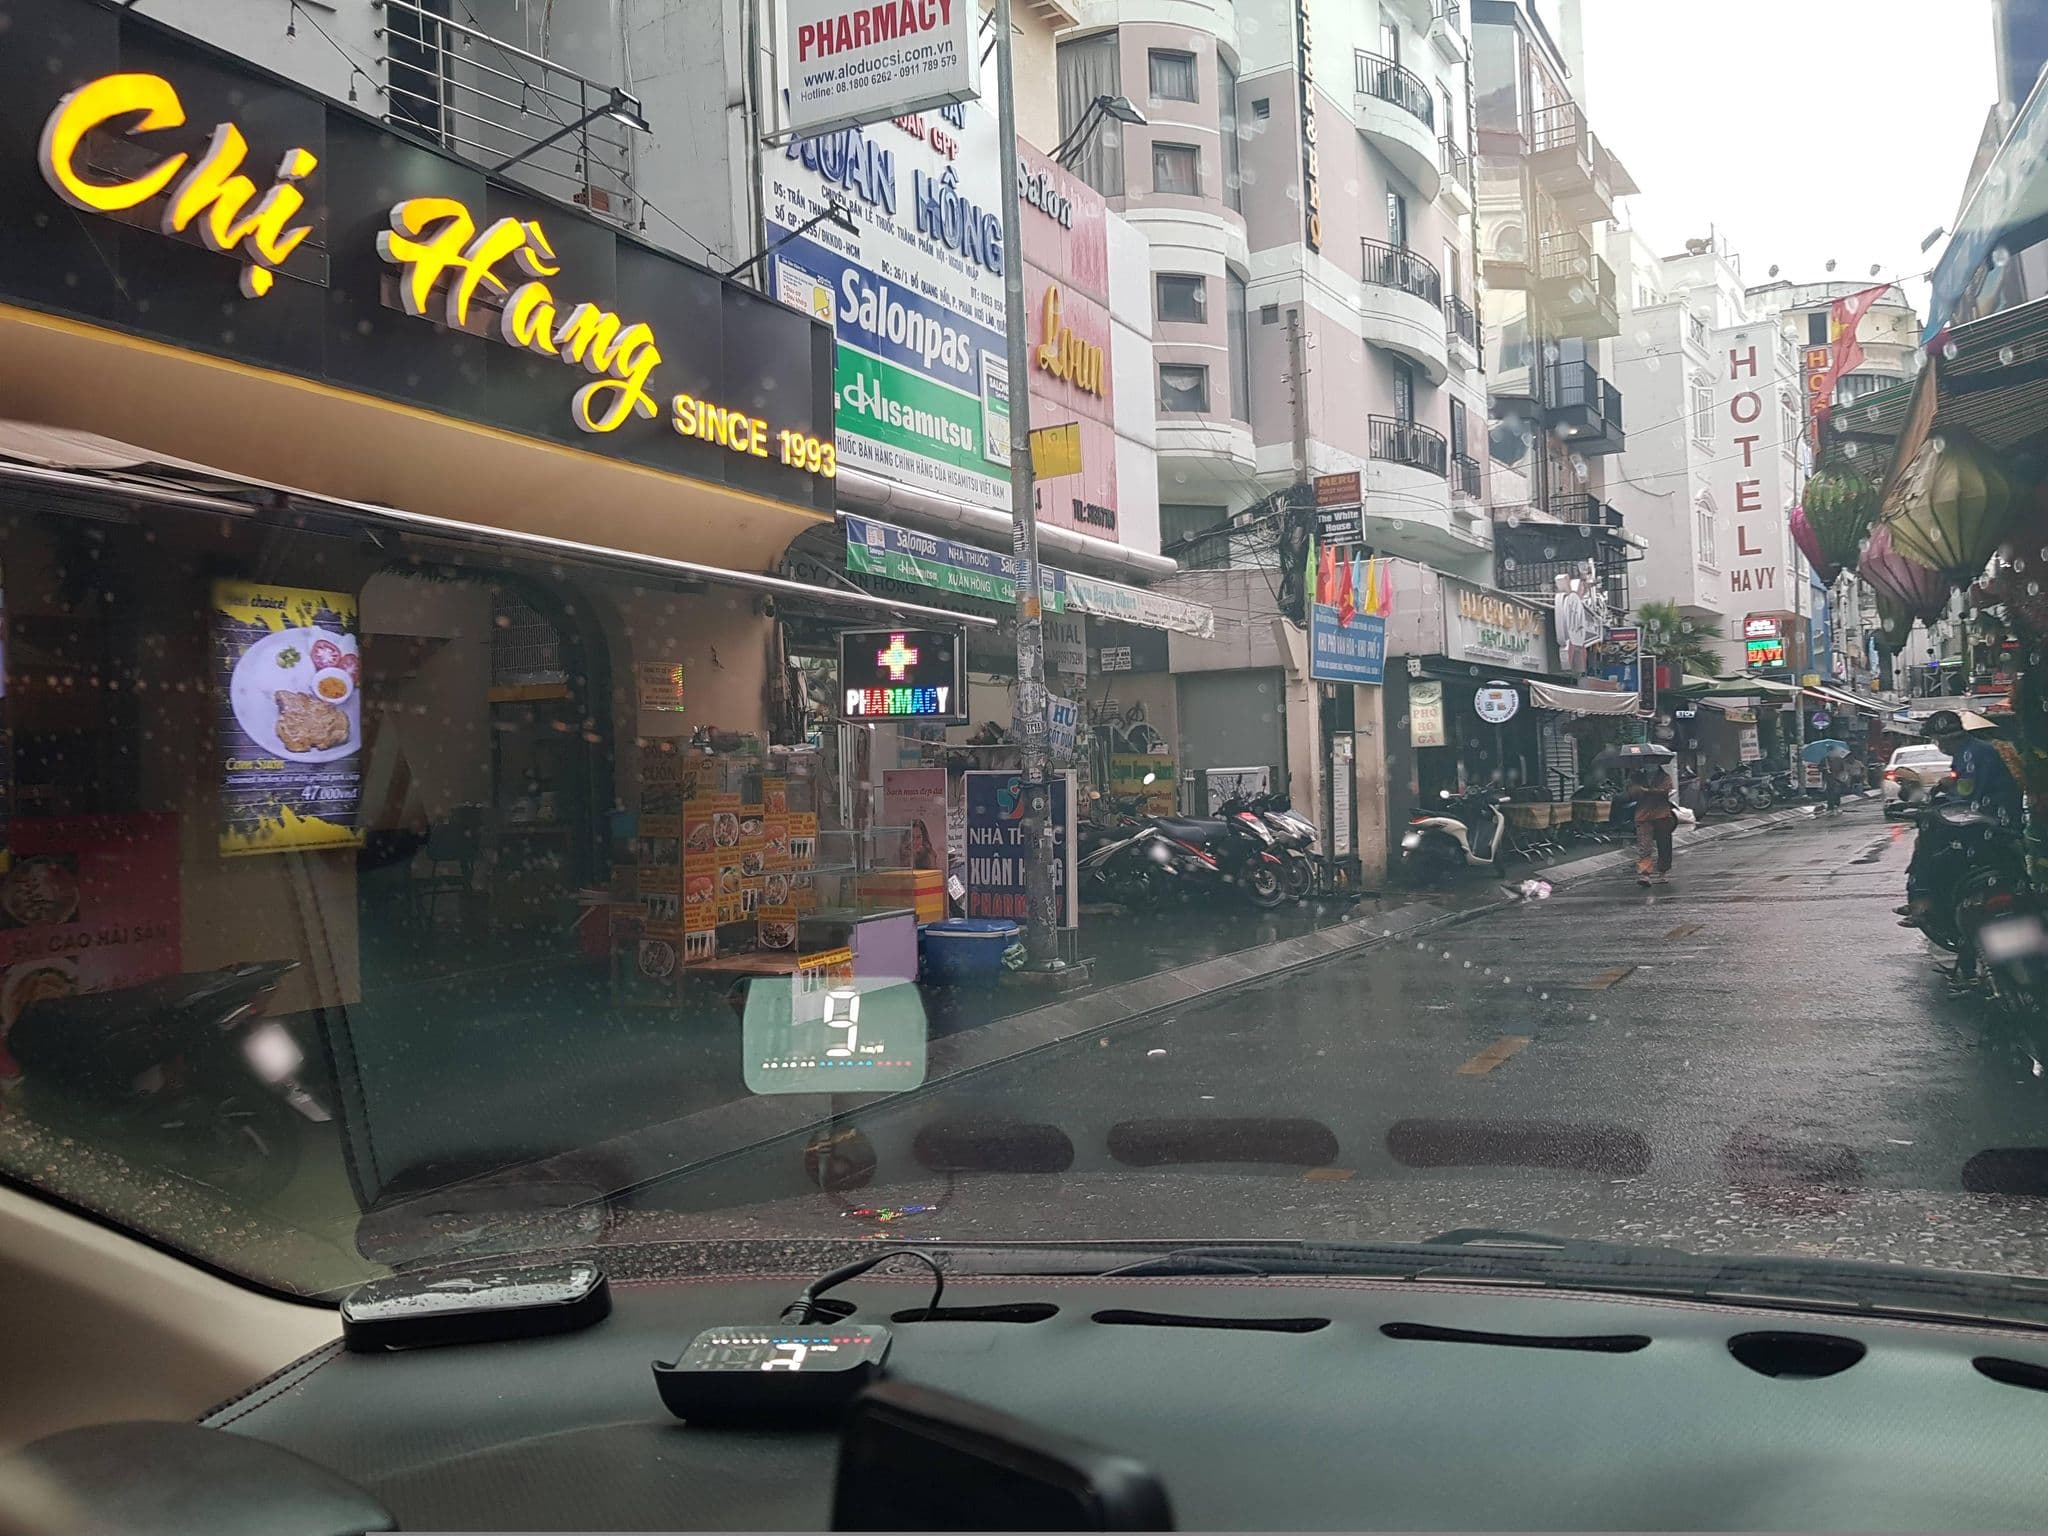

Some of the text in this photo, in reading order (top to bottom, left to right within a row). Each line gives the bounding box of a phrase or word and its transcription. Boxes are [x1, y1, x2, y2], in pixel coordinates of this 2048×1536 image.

[799, 0, 953, 62] PHARMACY
[801, 86, 834, 102] Hotline:
[836, 72, 870, 93] 08.1800
[871, 70, 892, 86] 6262
[900, 63, 920, 79] 0911
[922, 58, 939, 73] 789
[940, 54, 957, 69] 579
[804, 39, 953, 87] www.aloduocsi.com.vn
[914, 165, 1003, 277] HỒNG
[37, 72, 663, 434] Chị Hằng
[841, 268, 970, 373] Salonpas
[673, 393, 836, 479] SINCE 1993
[843, 373, 973, 451] Hisamitsu
[837, 434, 857, 455] HUỐC
[859, 441, 873, 459] BÁN
[874, 445, 893, 466] HÀNG
[894, 451, 915, 473] CHÍNH
[934, 464, 946, 482] CỦA
[948, 471, 979, 492] HISAMITSU
[979, 478, 991, 498] VIỆT
[992, 484, 1005, 499] NAM
[1729, 346, 1762, 556] HOTEL
[896, 530, 937, 556] Salonpas
[1325, 522, 1351, 532] House
[1334, 511, 1359, 521] White
[948, 571, 968, 588] XUÂN
[970, 576, 991, 593] HỒNG
[847, 687, 948, 715] PHARMACY
[970, 823, 1063, 845] NHÀ THC
[970, 852, 1063, 887] XUÂN HG
[823, 990, 861, 1057] 9
